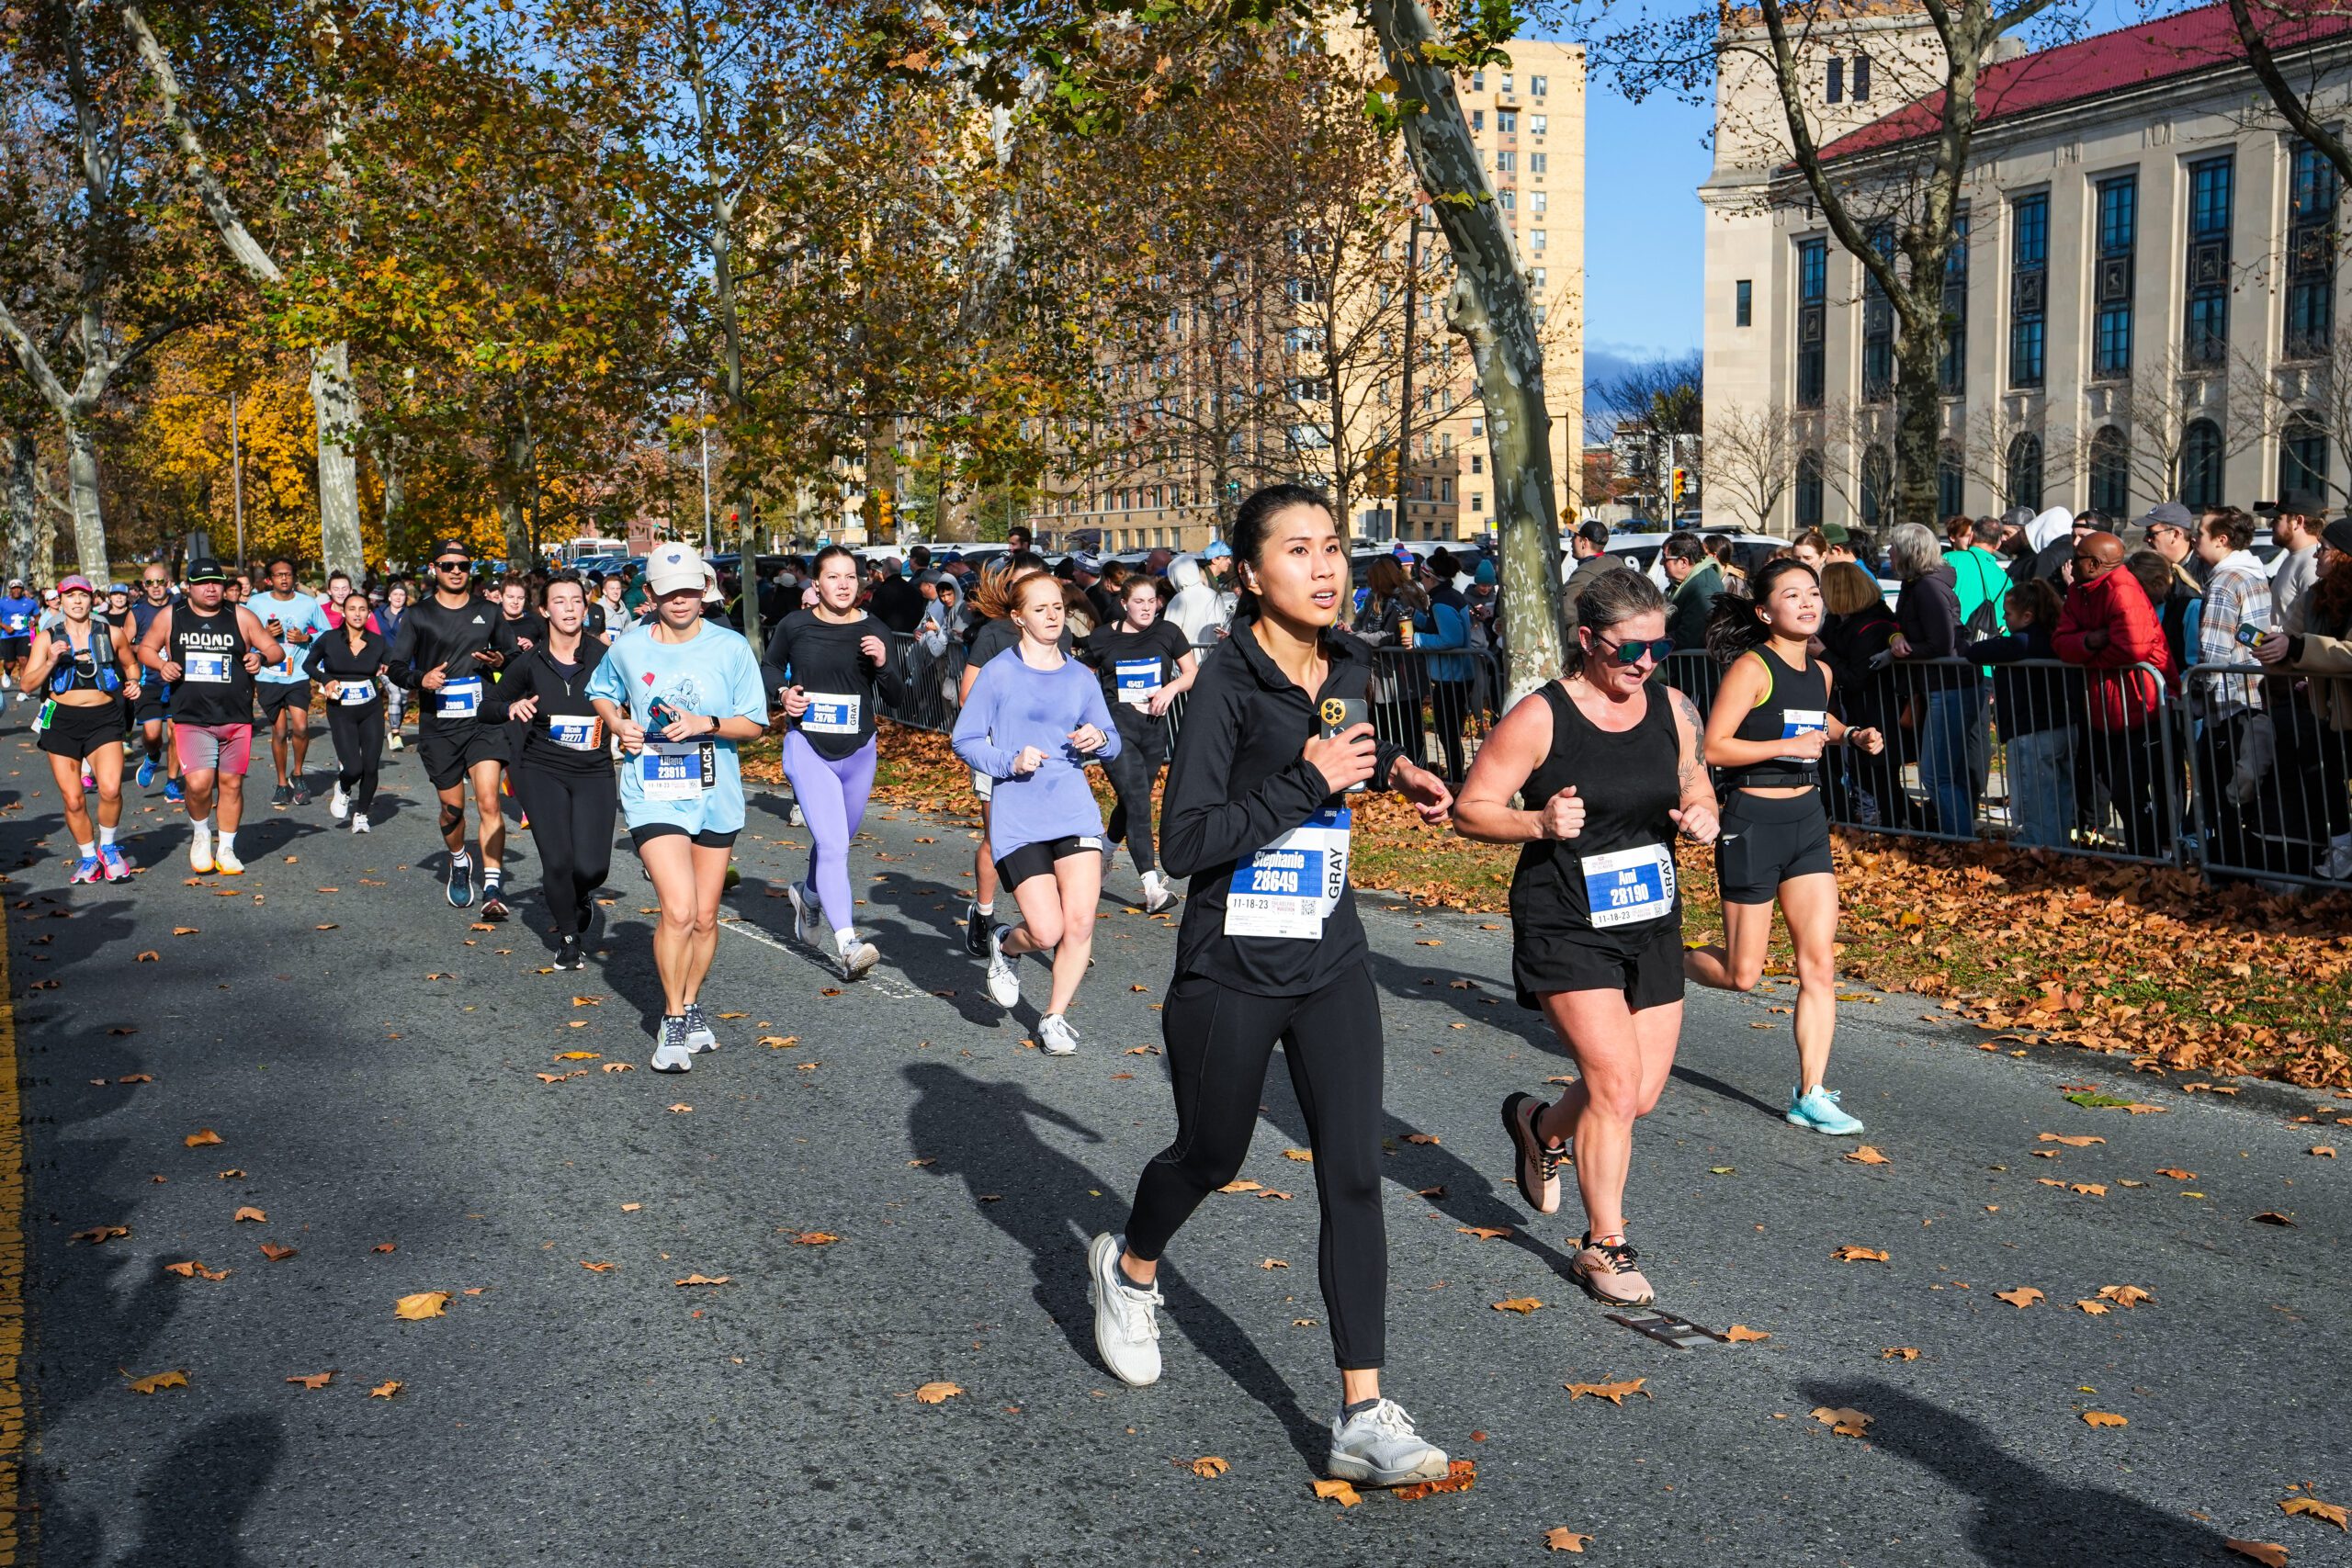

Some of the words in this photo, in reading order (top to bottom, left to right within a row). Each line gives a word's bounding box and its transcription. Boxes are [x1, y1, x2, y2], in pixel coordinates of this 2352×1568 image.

[1623, 556, 1641, 573] 9
[179, 632, 234, 647] HOUND
[560, 733, 583, 743] 32277
[658, 766, 687, 779] 23918
[703, 747, 713, 783] BLACK
[1252, 851, 1306, 871] Stephanie
[1251, 870, 1299, 893] 28649
[1329, 848, 1343, 899] GRAY
[1618, 868, 1638, 886] Ami
[1660, 858, 1673, 898] GRAY
[1233, 898, 1269, 909] 11-18-23
[1610, 883, 1650, 907] 28190
[1599, 911, 1631, 923] 11-18-23
